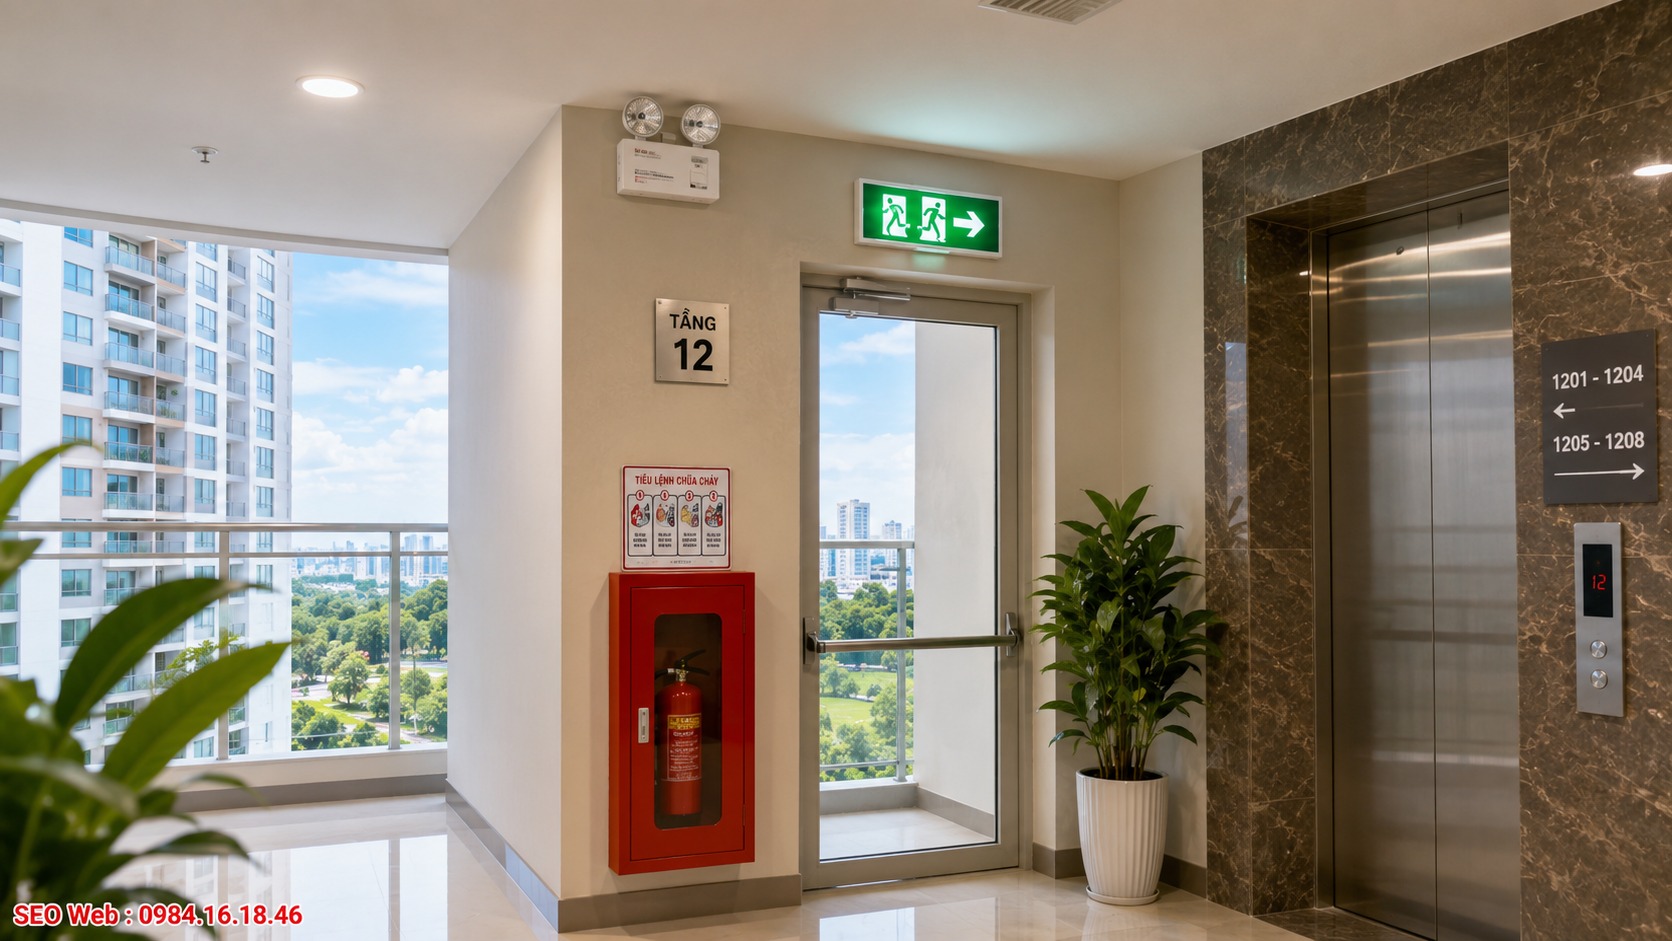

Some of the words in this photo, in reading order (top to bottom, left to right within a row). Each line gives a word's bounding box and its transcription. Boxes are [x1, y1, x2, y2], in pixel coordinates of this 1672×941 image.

[669, 307, 716, 331] TẦNG
[674, 338, 713, 371] 12
[1552, 370, 1587, 390] 1201
[1603, 364, 1644, 385] 1204
[1553, 434, 1590, 452] 1205
[1605, 431, 1645, 450] 1208
[1592, 574, 1607, 590] 12
